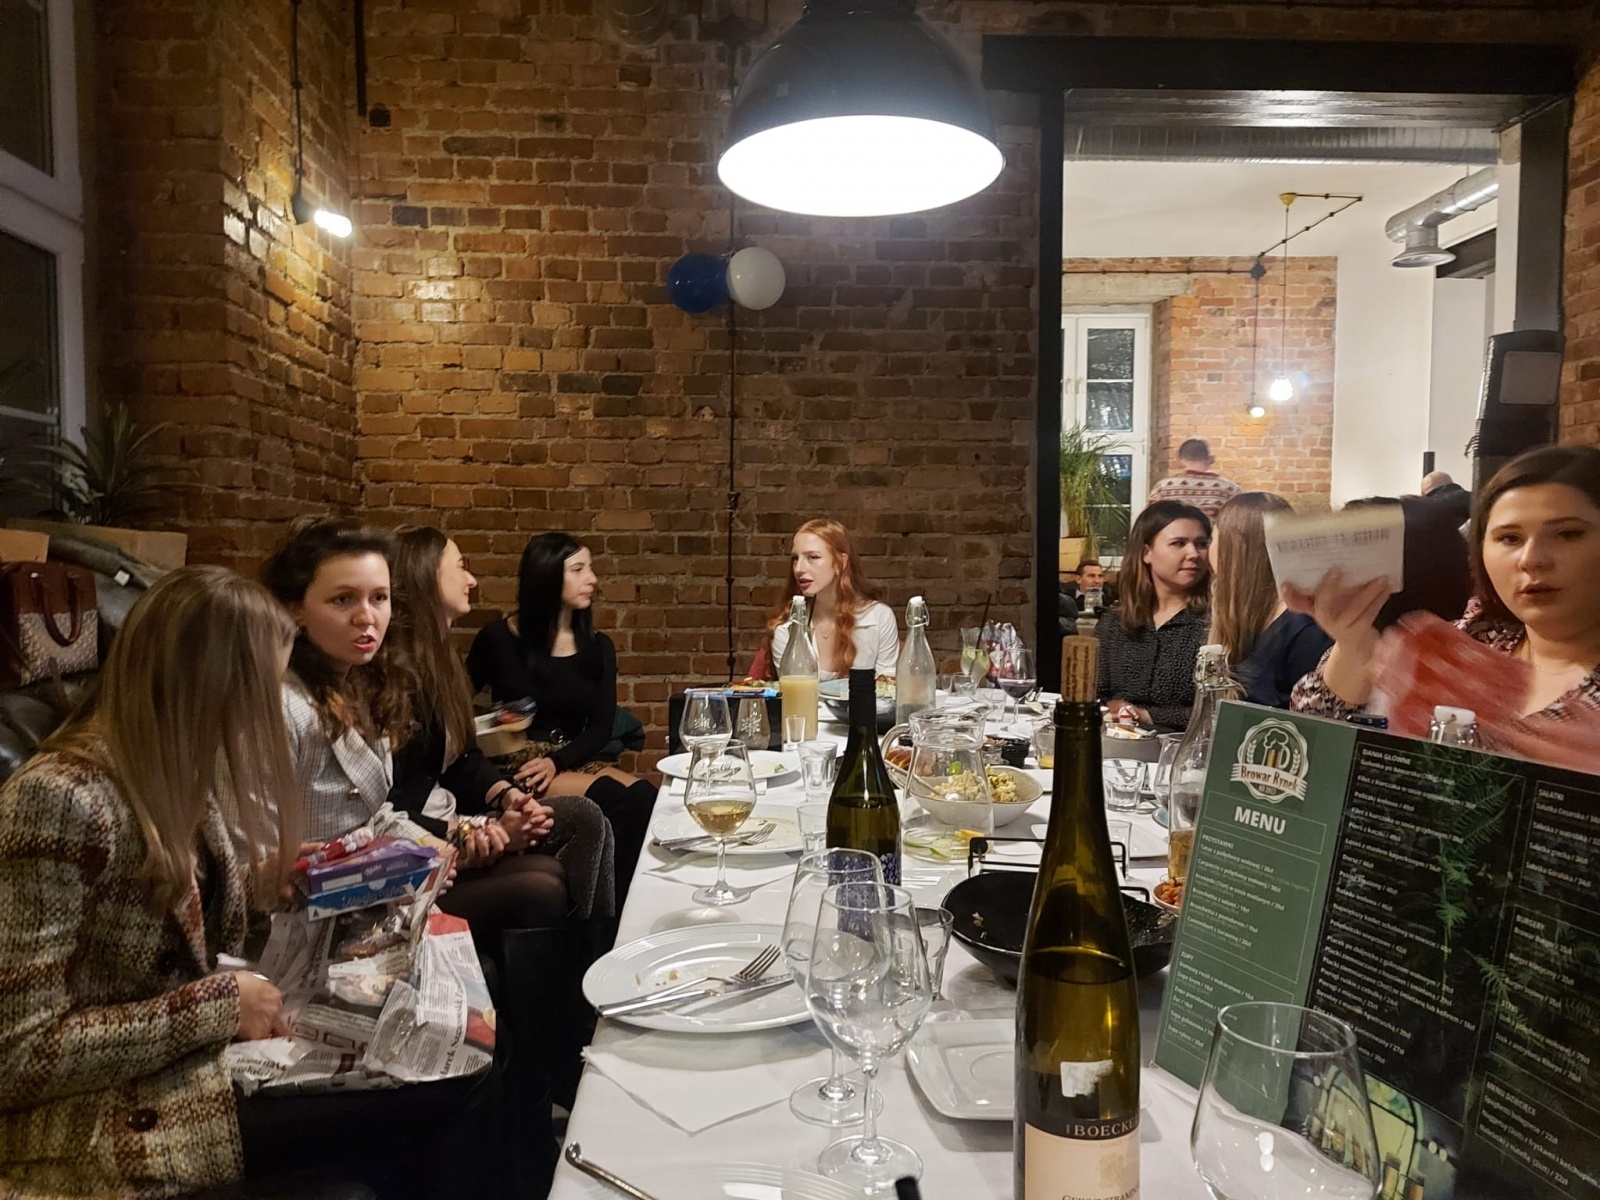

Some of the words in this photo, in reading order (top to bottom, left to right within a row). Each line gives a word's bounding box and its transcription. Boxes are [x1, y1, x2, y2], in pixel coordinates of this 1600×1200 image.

[1362, 749, 1383, 758] DANIA
[1360, 759, 1384, 769] Golonka
[1240, 765, 1271, 783] Browar
[1273, 769, 1298, 792] Rynek
[1357, 775, 1370, 783] Filet
[1374, 779, 1400, 790] kurczaka
[1407, 787, 1422, 796] sosie
[1354, 791, 1376, 801] Policzki
[1376, 797, 1398, 807] wołowe
[1538, 789, 1564, 800] SAŁATKI
[1234, 806, 1286, 834] MENU
[1535, 802, 1557, 813] Sałatka
[1557, 807, 1585, 820] Cesarska
[1348, 822, 1362, 830] Pierś
[1367, 827, 1385, 837] kaczki
[1351, 807, 1364, 815] Filet
[1368, 812, 1394, 824] kurczaka
[1400, 821, 1415, 830] sosie
[1415, 825, 1447, 840] grzybowym
[1532, 821, 1554, 833] Sałatka
[1200, 843, 1213, 852] Tatar
[1202, 834, 1233, 849] PRZYSTAWKI
[1342, 854, 1359, 864] Dorsz
[1345, 838, 1360, 847] Łosoś
[1366, 844, 1388, 856] masłem
[1388, 851, 1425, 868] koperkowym
[1528, 842, 1550, 854] Sałatka
[1550, 848, 1571, 861] grecka
[1197, 858, 1219, 871] Carpaccio
[1525, 861, 1547, 873] Sałatka
[1194, 873, 1215, 885] Krewetki
[1234, 887, 1246, 896] sosie
[1192, 887, 1217, 901] Bruschetta
[1221, 898, 1236, 908] salami
[1335, 887, 1355, 898] Rolada
[1355, 894, 1377, 906] wołowa
[1217, 913, 1245, 929] pomidorem
[1332, 903, 1363, 920] Największy
[1364, 915, 1380, 926] kotlet
[1381, 921, 1407, 938] schabowy
[1414, 934, 1435, 947] mieście
[1516, 914, 1544, 930] BURGERY
[1329, 919, 1361, 937] Polędwiczki
[1361, 931, 1391, 949] wieprzowe
[1180, 951, 1193, 961] ZUPY
[1326, 935, 1344, 947] Placek
[1344, 944, 1352, 952] po
[1383, 959, 1408, 976] gulaszem
[1409, 970, 1436, 987] wołowym
[1508, 952, 1527, 967] Burger
[1527, 961, 1556, 979] klasyczny
[1177, 970, 1188, 981] Zupa
[1188, 976, 1200, 986] krem
[1324, 945, 1341, 957] Placki
[1341, 953, 1377, 973] ziemniaczane
[1382, 970, 1406, 986] łososiem
[1409, 982, 1436, 1000] śmietaną
[1213, 977, 1241, 994] makaronem
[1318, 978, 1337, 992] Pierogi
[1341, 989, 1362, 1004] mięsem
[1320, 967, 1339, 981] Pierogi
[1339, 976, 1356, 988] ruskie
[1360, 985, 1382, 1001] cebulką
[1322, 956, 1339, 968] Placki
[1339, 964, 1375, 985] ziemniaczane
[1398, 991, 1425, 1009] śmietaną
[1425, 1003, 1435, 1012] lub
[1435, 1008, 1459, 1023] kefirem
[1504, 977, 1523, 992] Burger
[1174, 985, 1185, 996] Zupa
[1185, 991, 1213, 1010] pomidorowa
[1170, 1009, 1181, 1020] Zupa
[1366, 1013, 1395, 1032] pietruszką
[1167, 1024, 1178, 1035] Zupa
[1354, 1025, 1388, 1048] panierowany
[1495, 1033, 1507, 1044] Stek
[1544, 1036, 1571, 1056] wołowej
[1483, 1095, 1510, 1118] Spaghetti
[1486, 1081, 1505, 1098] MENU
[1505, 1092, 1536, 1116] DZIECIĘCE
[1479, 1123, 1506, 1146] Naleśniki
[1509, 1143, 1530, 1164] nutellą
[1559, 1157, 1597, 1188] ketchupem
